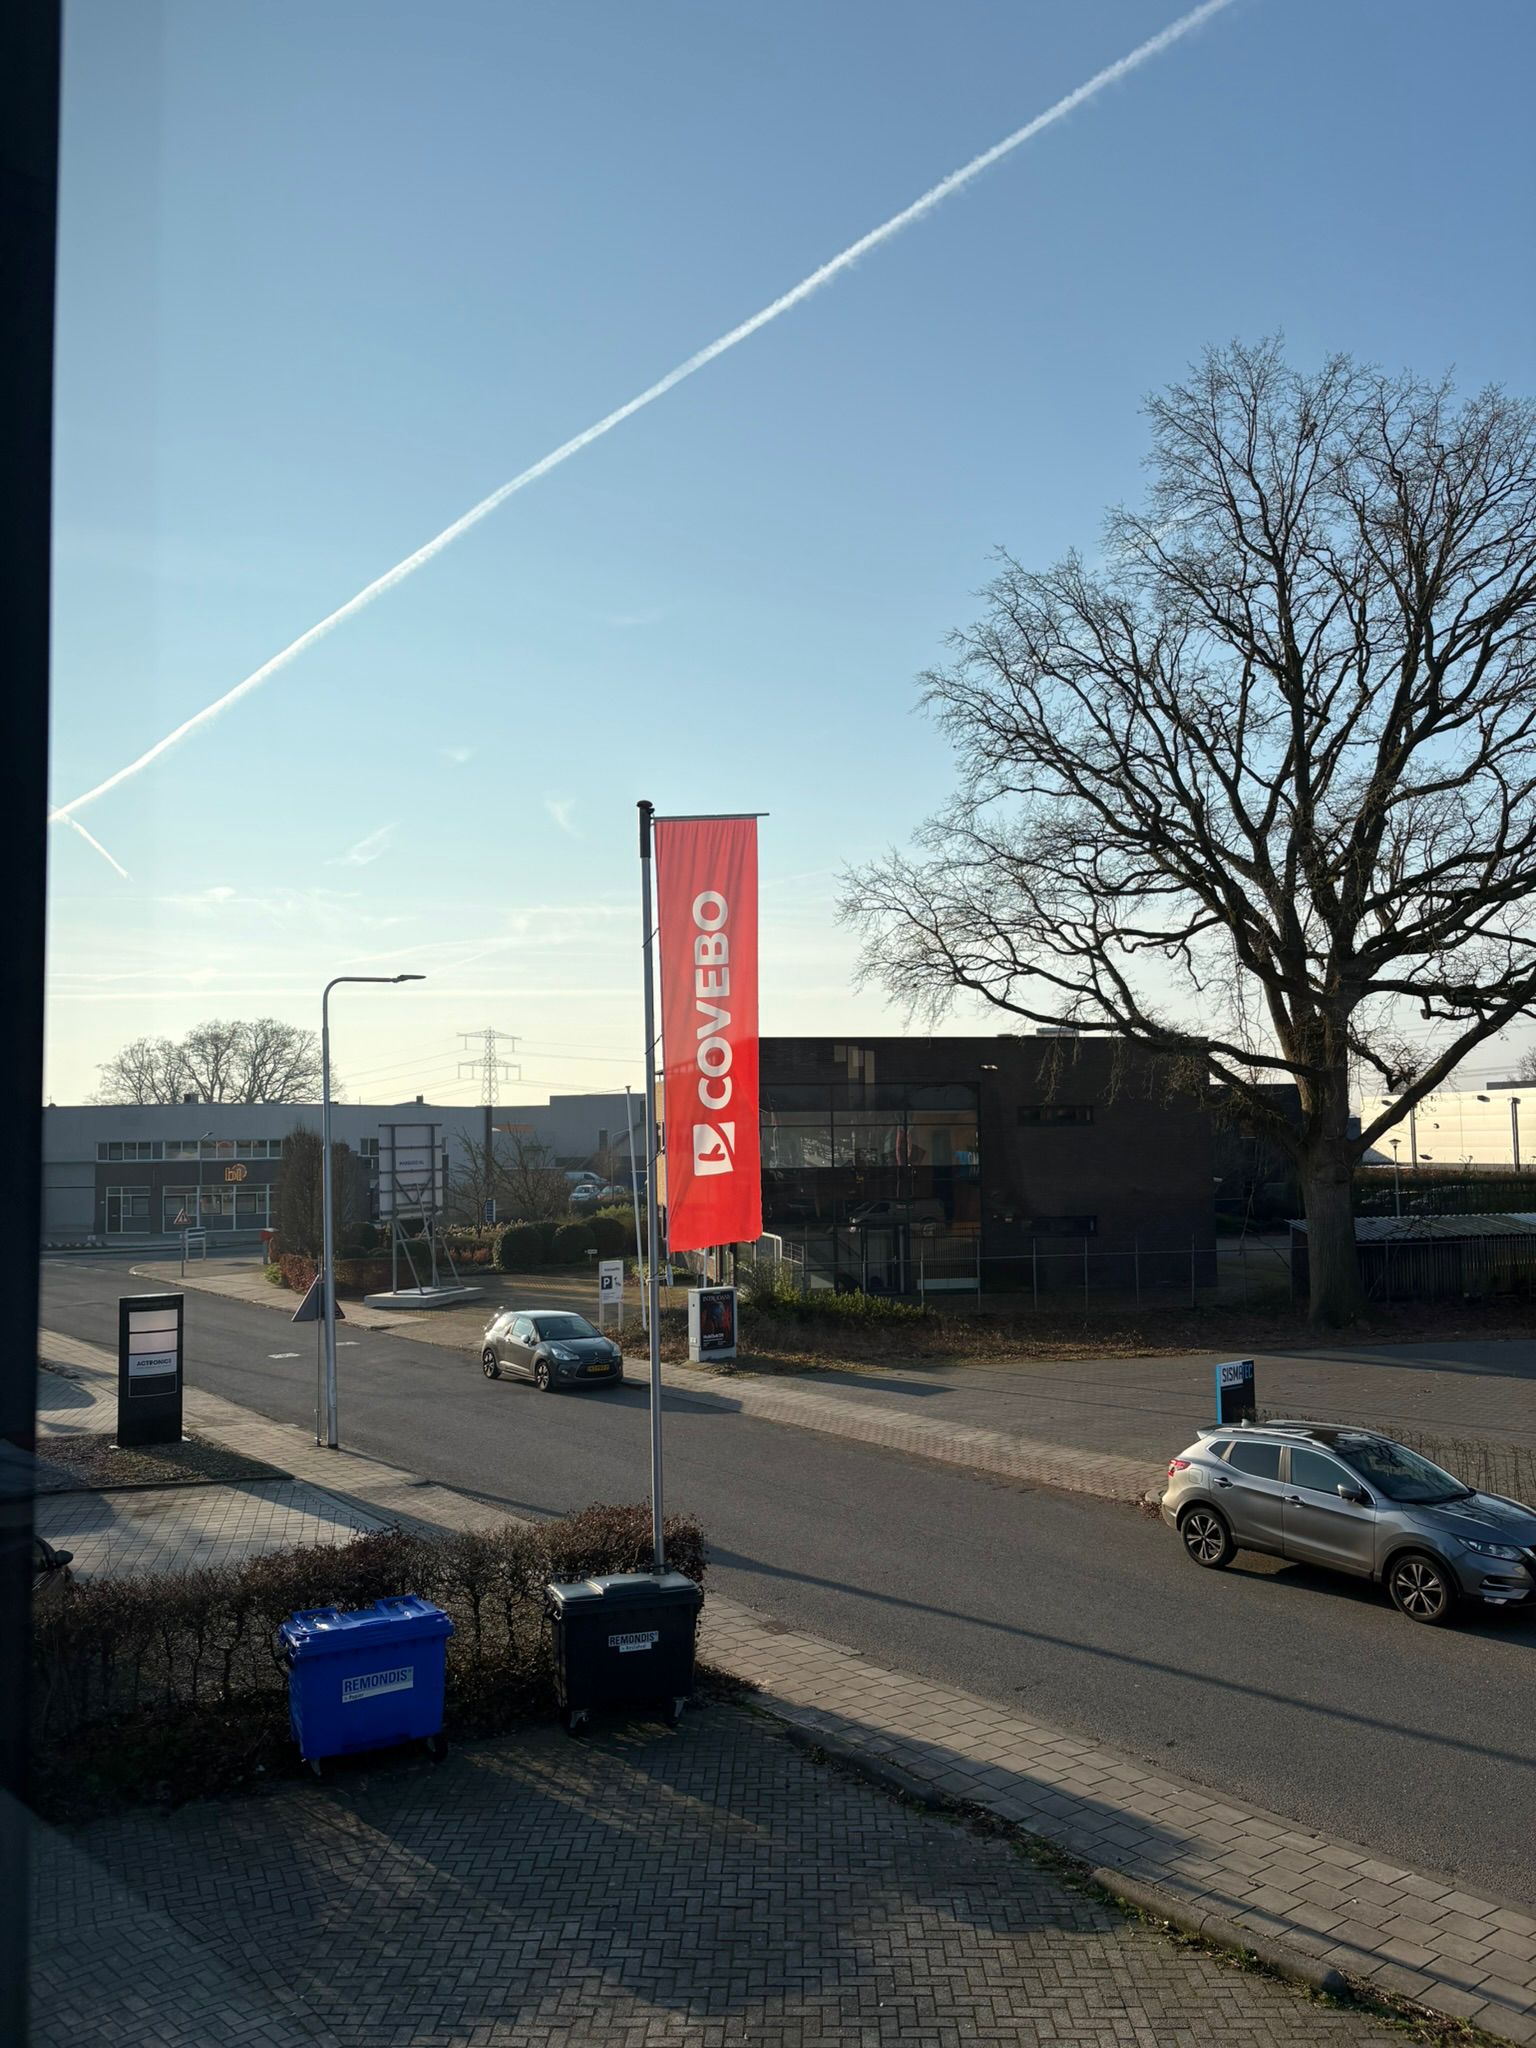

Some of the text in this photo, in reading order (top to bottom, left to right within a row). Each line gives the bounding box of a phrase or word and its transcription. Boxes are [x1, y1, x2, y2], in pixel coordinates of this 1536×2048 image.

[692, 890, 733, 1110] COVEBO
[1221, 1362, 1253, 1383] SISMATEC
[609, 1632, 655, 1646] REMONDIS
[344, 1669, 408, 1693] REMONDIS
